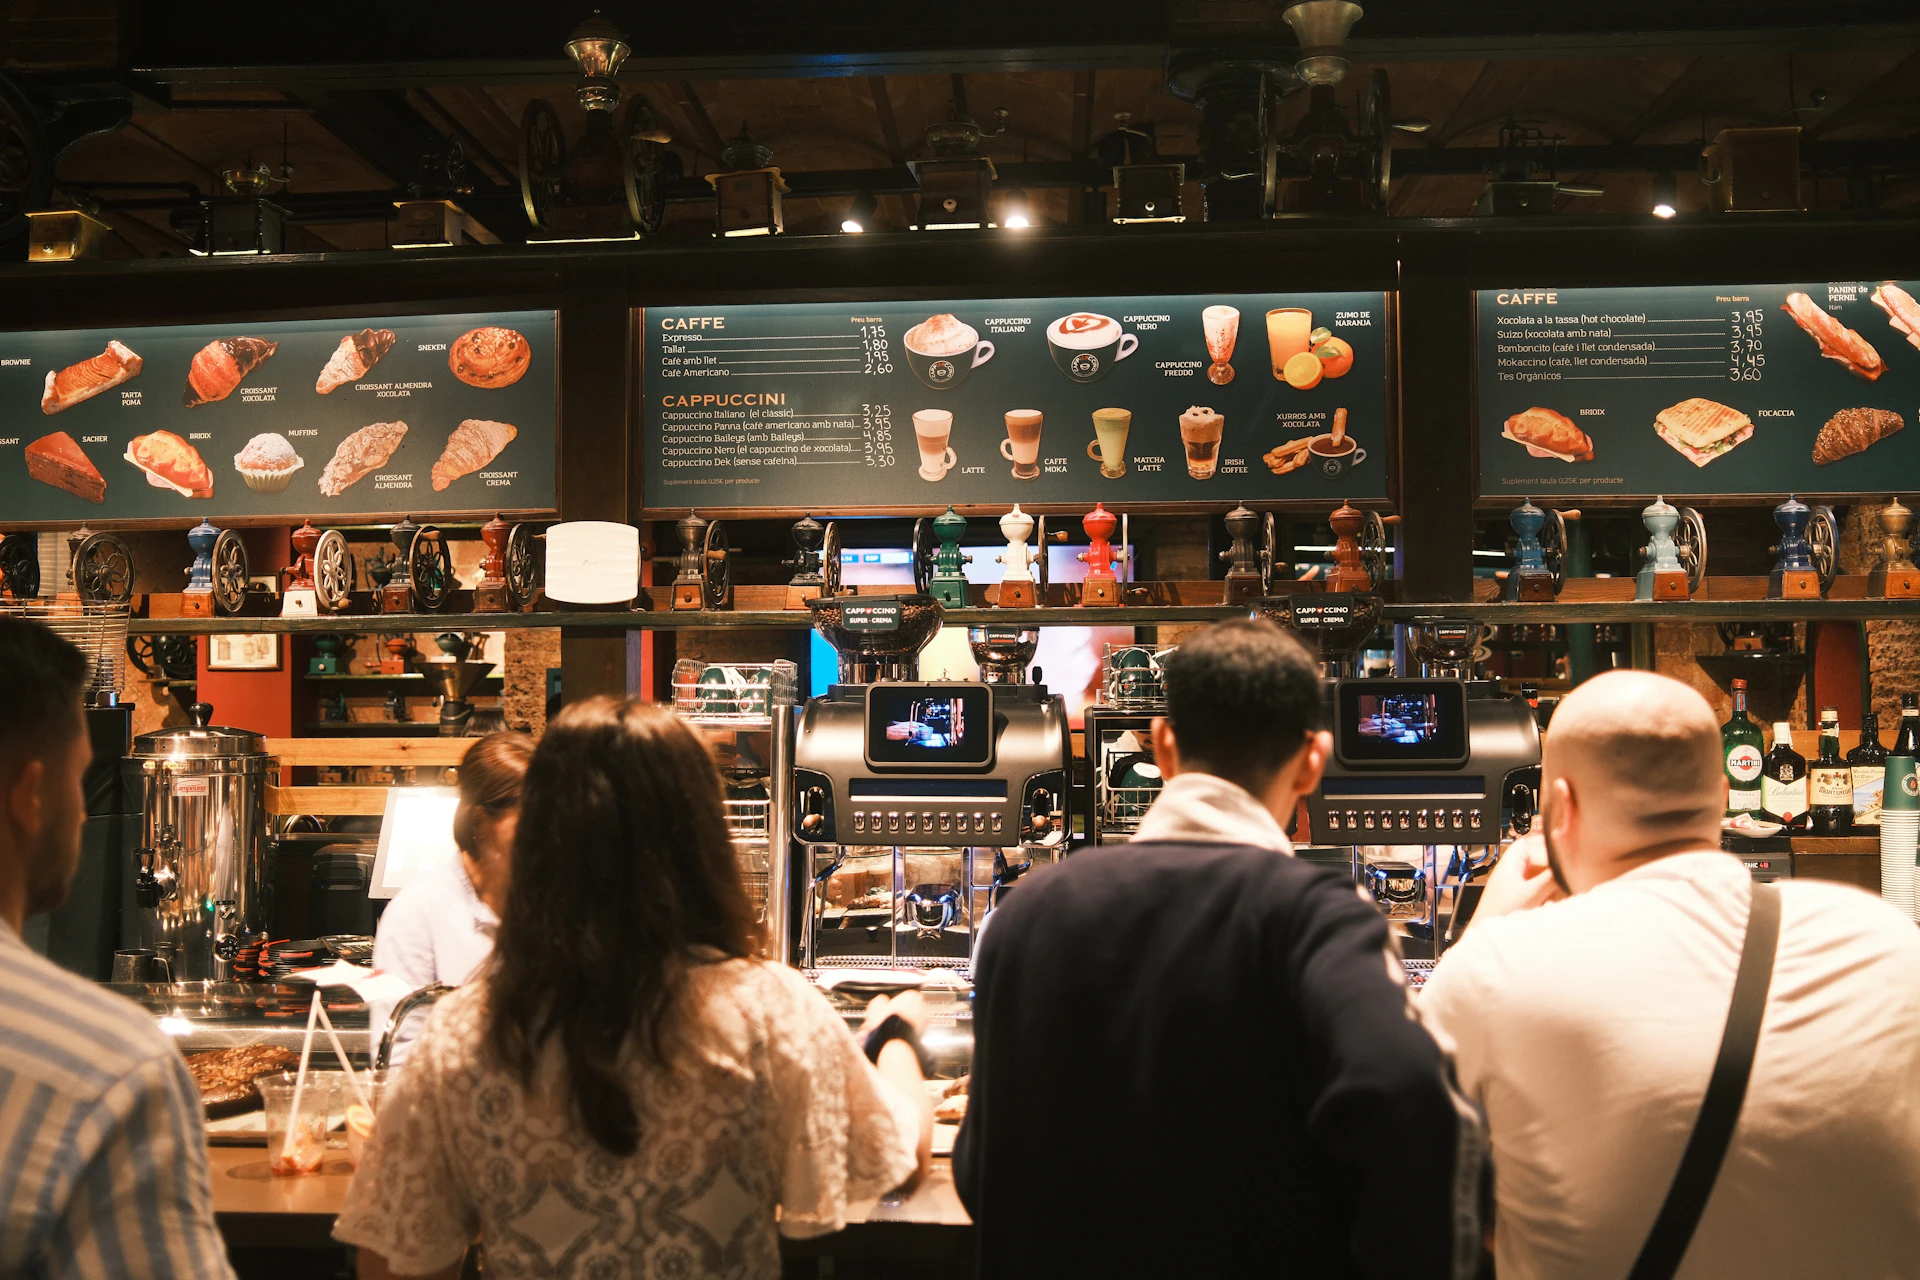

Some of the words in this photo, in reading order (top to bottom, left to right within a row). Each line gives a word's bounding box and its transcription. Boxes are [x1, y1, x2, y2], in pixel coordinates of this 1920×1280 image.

[1828, 286, 1857, 294] PANINI
[1496, 292, 1558, 305] CAFFE
[1828, 294, 1858, 302] PERNIL
[1123, 315, 1170, 323] CAPPUCCINO
[1360, 311, 1371, 319] DE
[1497, 315, 1535, 325] Xocolata
[1544, 315, 1553, 324] la
[1555, 316, 1579, 324] tassa
[1581, 314, 1598, 324] (hot
[1600, 313, 1646, 324] chocolate)
[1731, 309, 1764, 323] 3,95
[661, 316, 725, 331] CAFFE
[850, 316, 865, 324] Preu
[985, 317, 1032, 326] CAPPUCCINO
[1335, 319, 1372, 327] NARANJA
[860, 325, 886, 339] 1,75
[1497, 330, 1523, 339] Suizo
[1524, 329, 1565, 339] (xocolata
[1566, 329, 1587, 338] amb
[1588, 328, 1612, 338] nata)
[1731, 323, 1763, 339] 3,95
[662, 333, 702, 343] Expresso
[662, 345, 686, 354] Tallat
[862, 339, 889, 351] 1,80
[1497, 344, 1551, 353] Bomboncito
[1576, 343, 1580, 352] i
[1581, 342, 1596, 352] llet
[1597, 341, 1656, 352] condensada)
[1730, 339, 1763, 354] 3,70
[683, 356, 702, 365] amb
[703, 356, 717, 365] llet
[864, 350, 889, 364] 1,95
[1497, 358, 1547, 367] Mokaccino
[1574, 356, 1588, 366] llet
[1590, 355, 1648, 366] condensada)
[1730, 354, 1766, 368] 4,45
[864, 363, 894, 375] 2,60
[1155, 361, 1203, 369] CAPPUCCINO
[683, 368, 730, 377] Americano
[1497, 372, 1514, 381] Tes
[1729, 367, 1762, 381] 3,60
[240, 387, 278, 395] CROISSANT
[355, 383, 393, 391] CROISSANT
[376, 390, 411, 398] XOCOLATA
[662, 393, 786, 408] CAPPUCCINI
[662, 410, 713, 421] Cappuccino
[713, 410, 746, 419] Italiano
[749, 409, 760, 419] (el
[861, 403, 892, 418] 3,25
[1758, 409, 1795, 417] FOCACCIA
[1308, 412, 1326, 420] AMB
[662, 422, 713, 433] Cappuccino
[714, 422, 741, 431] Panna
[765, 421, 811, 430] americano
[812, 420, 831, 429] amb
[833, 419, 855, 429] nata)
[863, 418, 892, 430] 3,95
[189, 432, 212, 440] BRIOIX
[288, 429, 318, 437] MUFFINS
[863, 430, 892, 442] 4,85
[82, 435, 108, 443] SACHER
[662, 434, 713, 445] Cappuccino
[714, 433, 746, 443] Baileys
[747, 432, 768, 443] (amb
[770, 432, 805, 443] Baileys)
[662, 446, 713, 457] Cappuccino
[714, 446, 736, 454] Nero
[737, 445, 747, 455] (el
[749, 445, 799, 455] cappuccino
[800, 444, 812, 453] de
[813, 443, 852, 454] xocolata)
[864, 442, 894, 455] 3,95
[662, 458, 713, 468] Cappuccino
[714, 457, 731, 466] Dek
[733, 456, 761, 467] (sense
[864, 455, 896, 468] 3,30
[1134, 456, 1165, 464] MATCHA
[1224, 458, 1245, 466] IRISH
[1137, 464, 1162, 472] LATTE
[1221, 466, 1249, 474] COFFEE
[374, 474, 413, 482] CROISSANT
[479, 471, 519, 479] CROISSANT
[374, 481, 413, 489] ALMENDRA
[486, 479, 511, 487] CREMA
[1502, 477, 1539, 485] Suplement
[1592, 476, 1624, 485] producte
[1729, 759, 1761, 767] MARTINI
